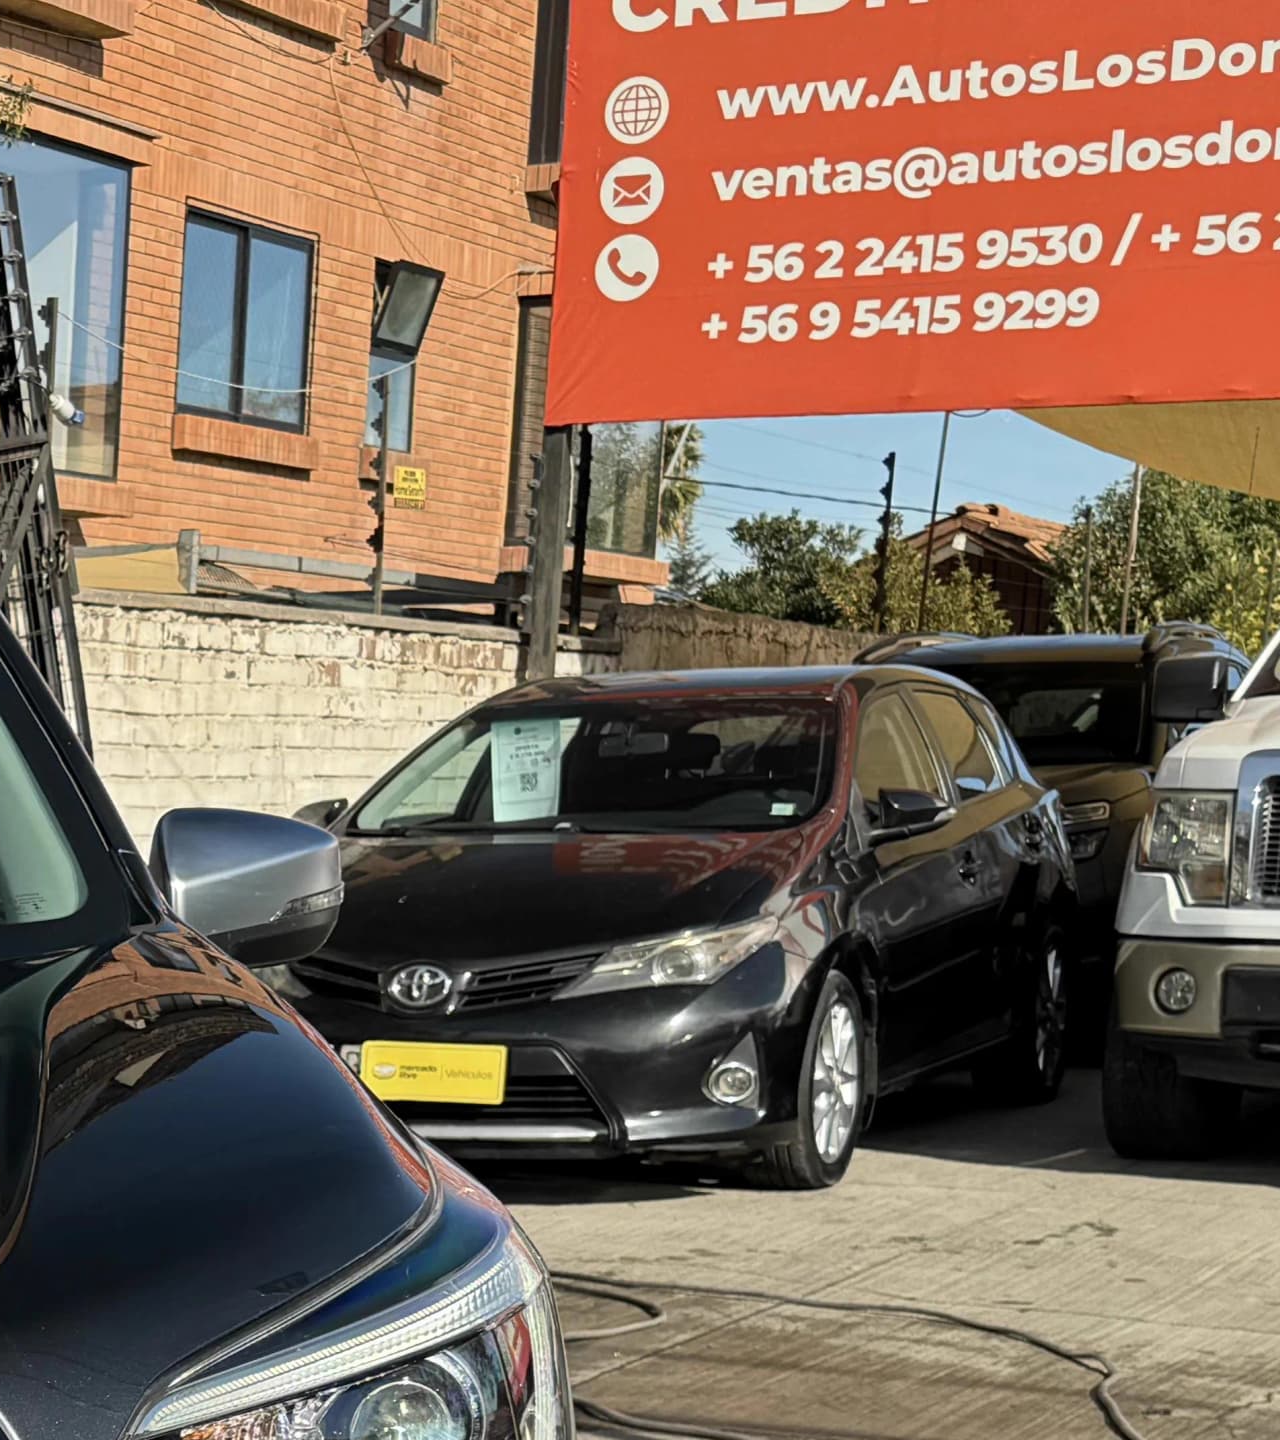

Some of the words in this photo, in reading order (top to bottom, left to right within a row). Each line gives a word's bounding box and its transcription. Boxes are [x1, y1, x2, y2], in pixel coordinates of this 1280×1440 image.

[711, 119, 1280, 201] ventas@autoslosdo
[707, 252, 734, 280] +
[743, 242, 805, 283] 56
[813, 239, 845, 279] 2
[854, 232, 965, 277] 2415
[975, 223, 1103, 270] 9530
[1110, 212, 1144, 266] /
[1151, 223, 1181, 252] +
[1192, 211, 1262, 256] 56
[701, 312, 728, 340] +
[737, 303, 799, 344] 56
[808, 301, 841, 341] 9
[850, 294, 961, 338] 5415
[972, 287, 1100, 332] 9299
